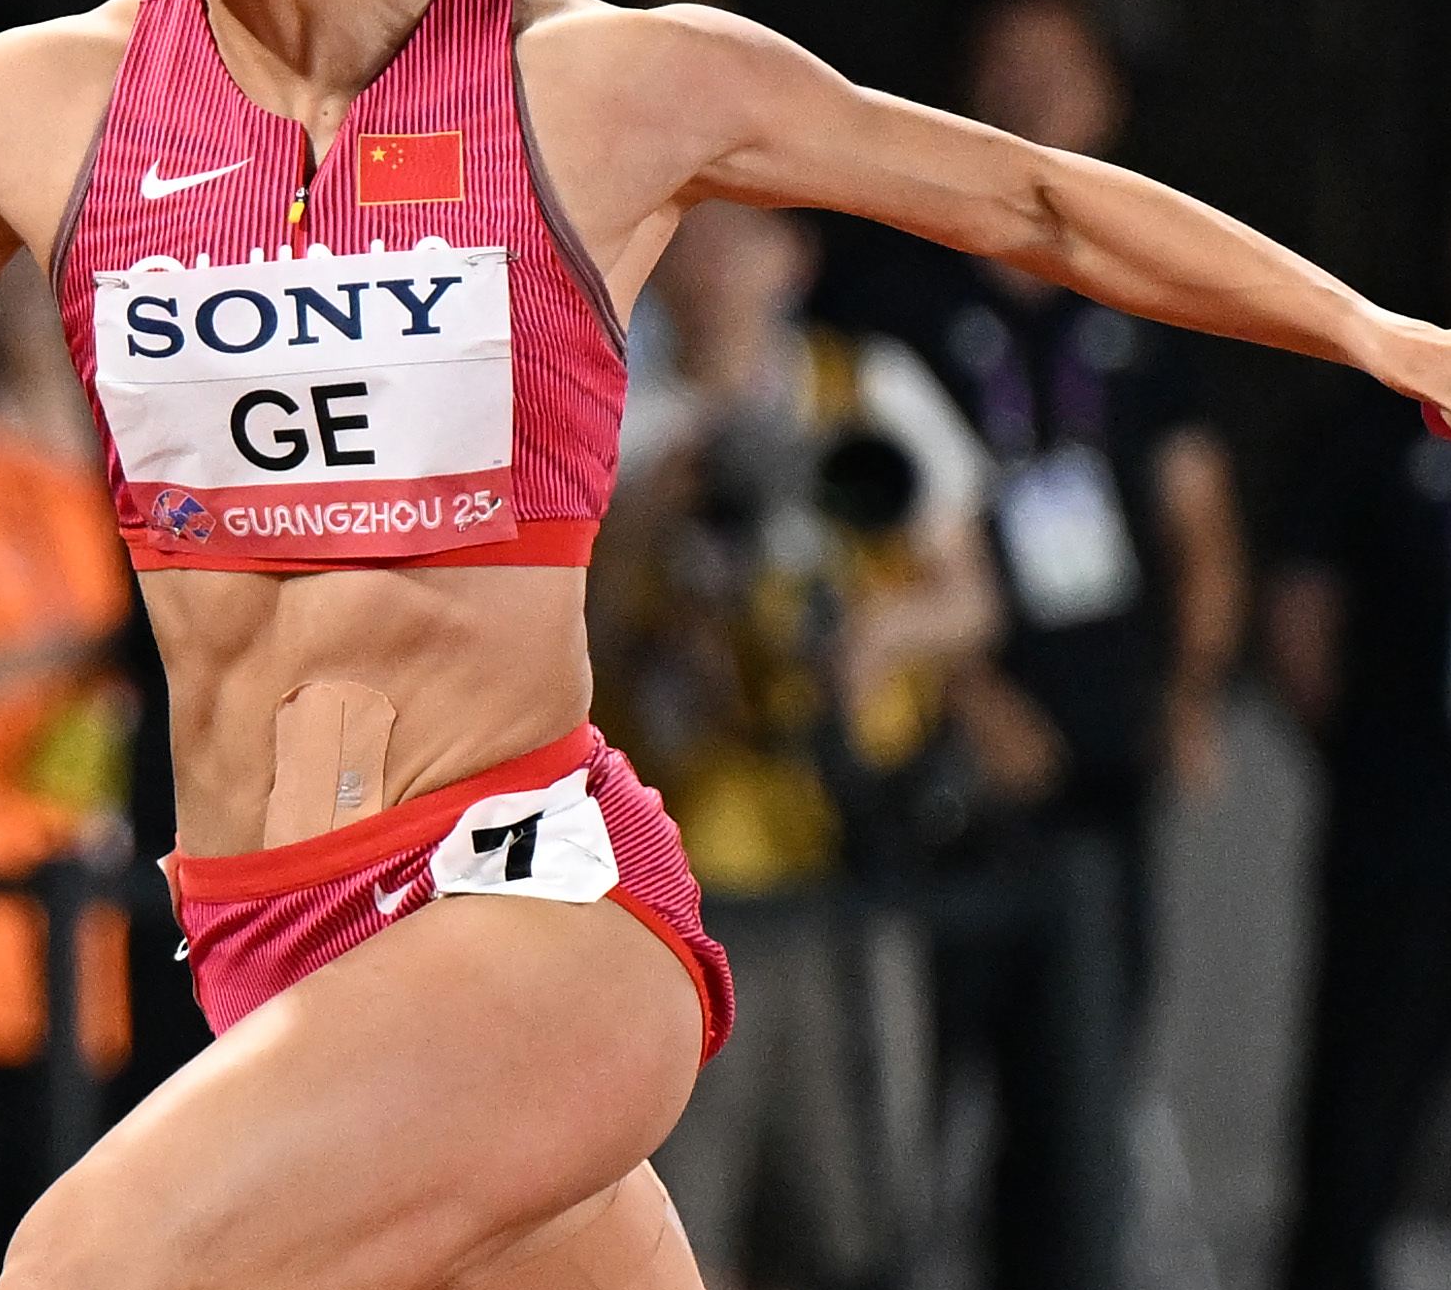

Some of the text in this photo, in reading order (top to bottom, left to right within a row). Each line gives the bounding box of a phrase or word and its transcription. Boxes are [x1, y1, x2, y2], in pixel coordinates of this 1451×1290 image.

[126, 276, 462, 358] SONY
[230, 381, 376, 471] GE
[224, 490, 494, 537] GUANGZHOU 25
[471, 809, 546, 882] 7
